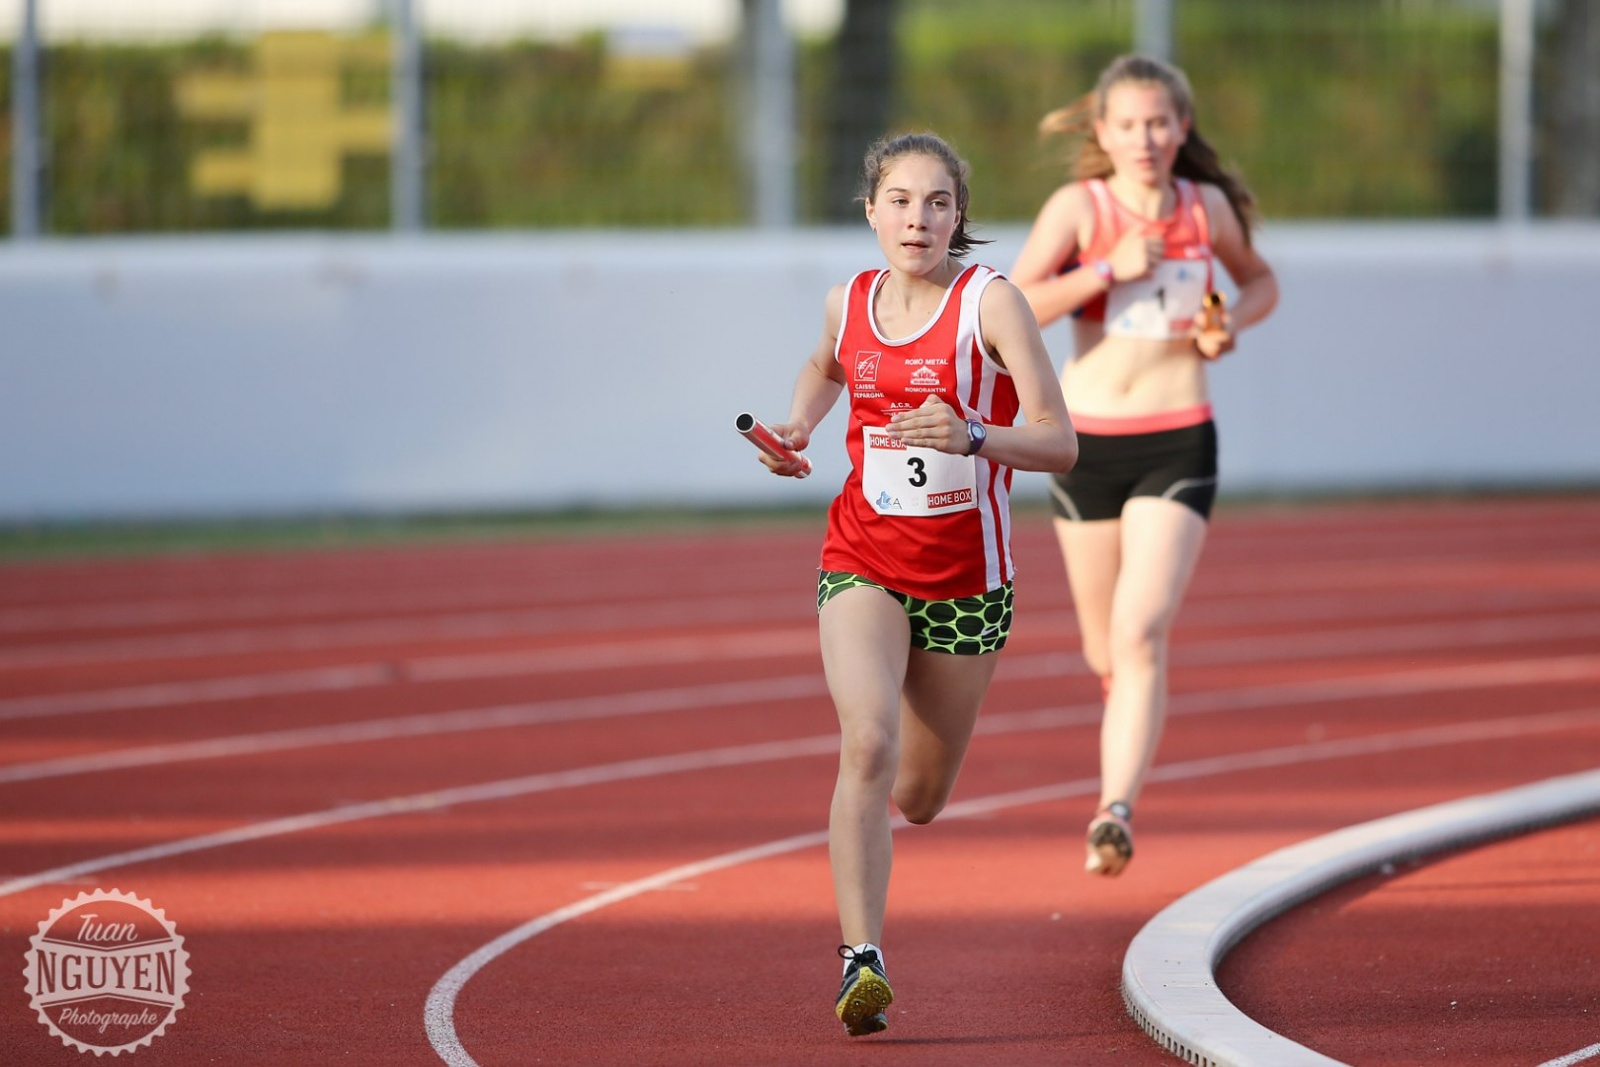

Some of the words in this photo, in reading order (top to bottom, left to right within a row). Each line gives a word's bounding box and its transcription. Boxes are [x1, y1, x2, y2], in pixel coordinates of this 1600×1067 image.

[869, 436, 890, 447] HOME
[907, 457, 927, 487] 3
[928, 497, 953, 507] HOME
[954, 491, 972, 503] BOX
